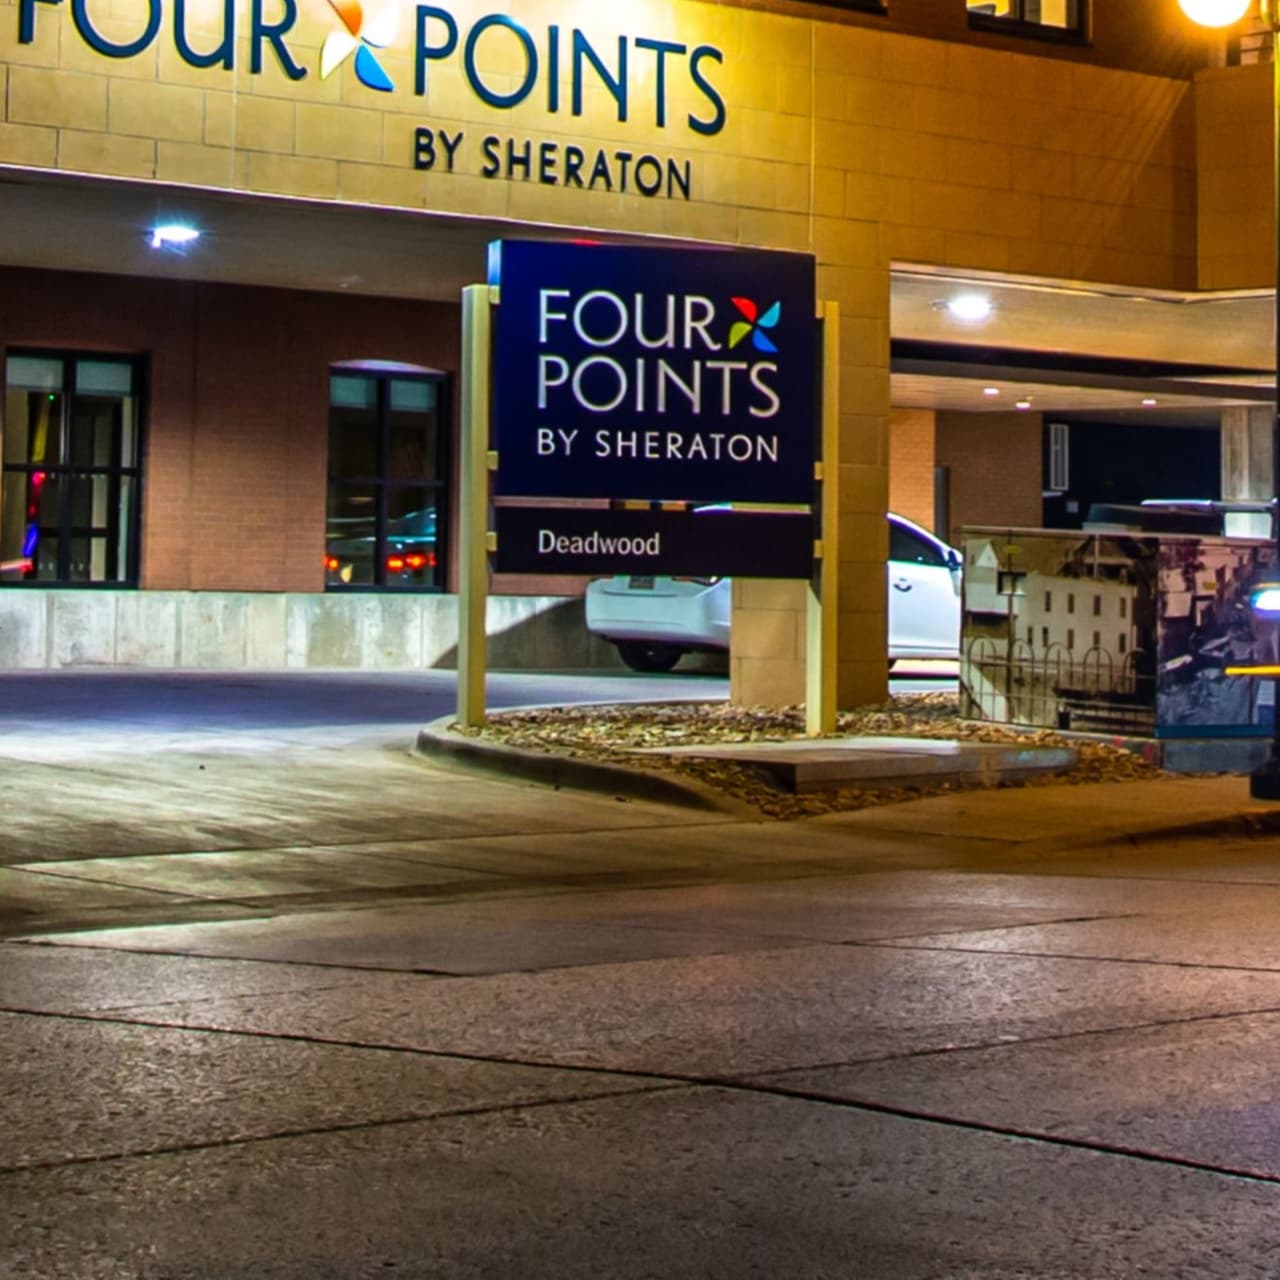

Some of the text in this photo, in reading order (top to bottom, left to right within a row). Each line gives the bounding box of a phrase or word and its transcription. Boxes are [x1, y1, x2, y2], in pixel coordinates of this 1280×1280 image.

[414, 4, 728, 136] POINTS
[414, 128, 693, 201] BY SHERATON
[538, 288, 723, 352] FOUR
[537, 354, 781, 419] POINTS
[537, 428, 779, 463] BY SHERATON
[538, 528, 661, 556] Deadwood
